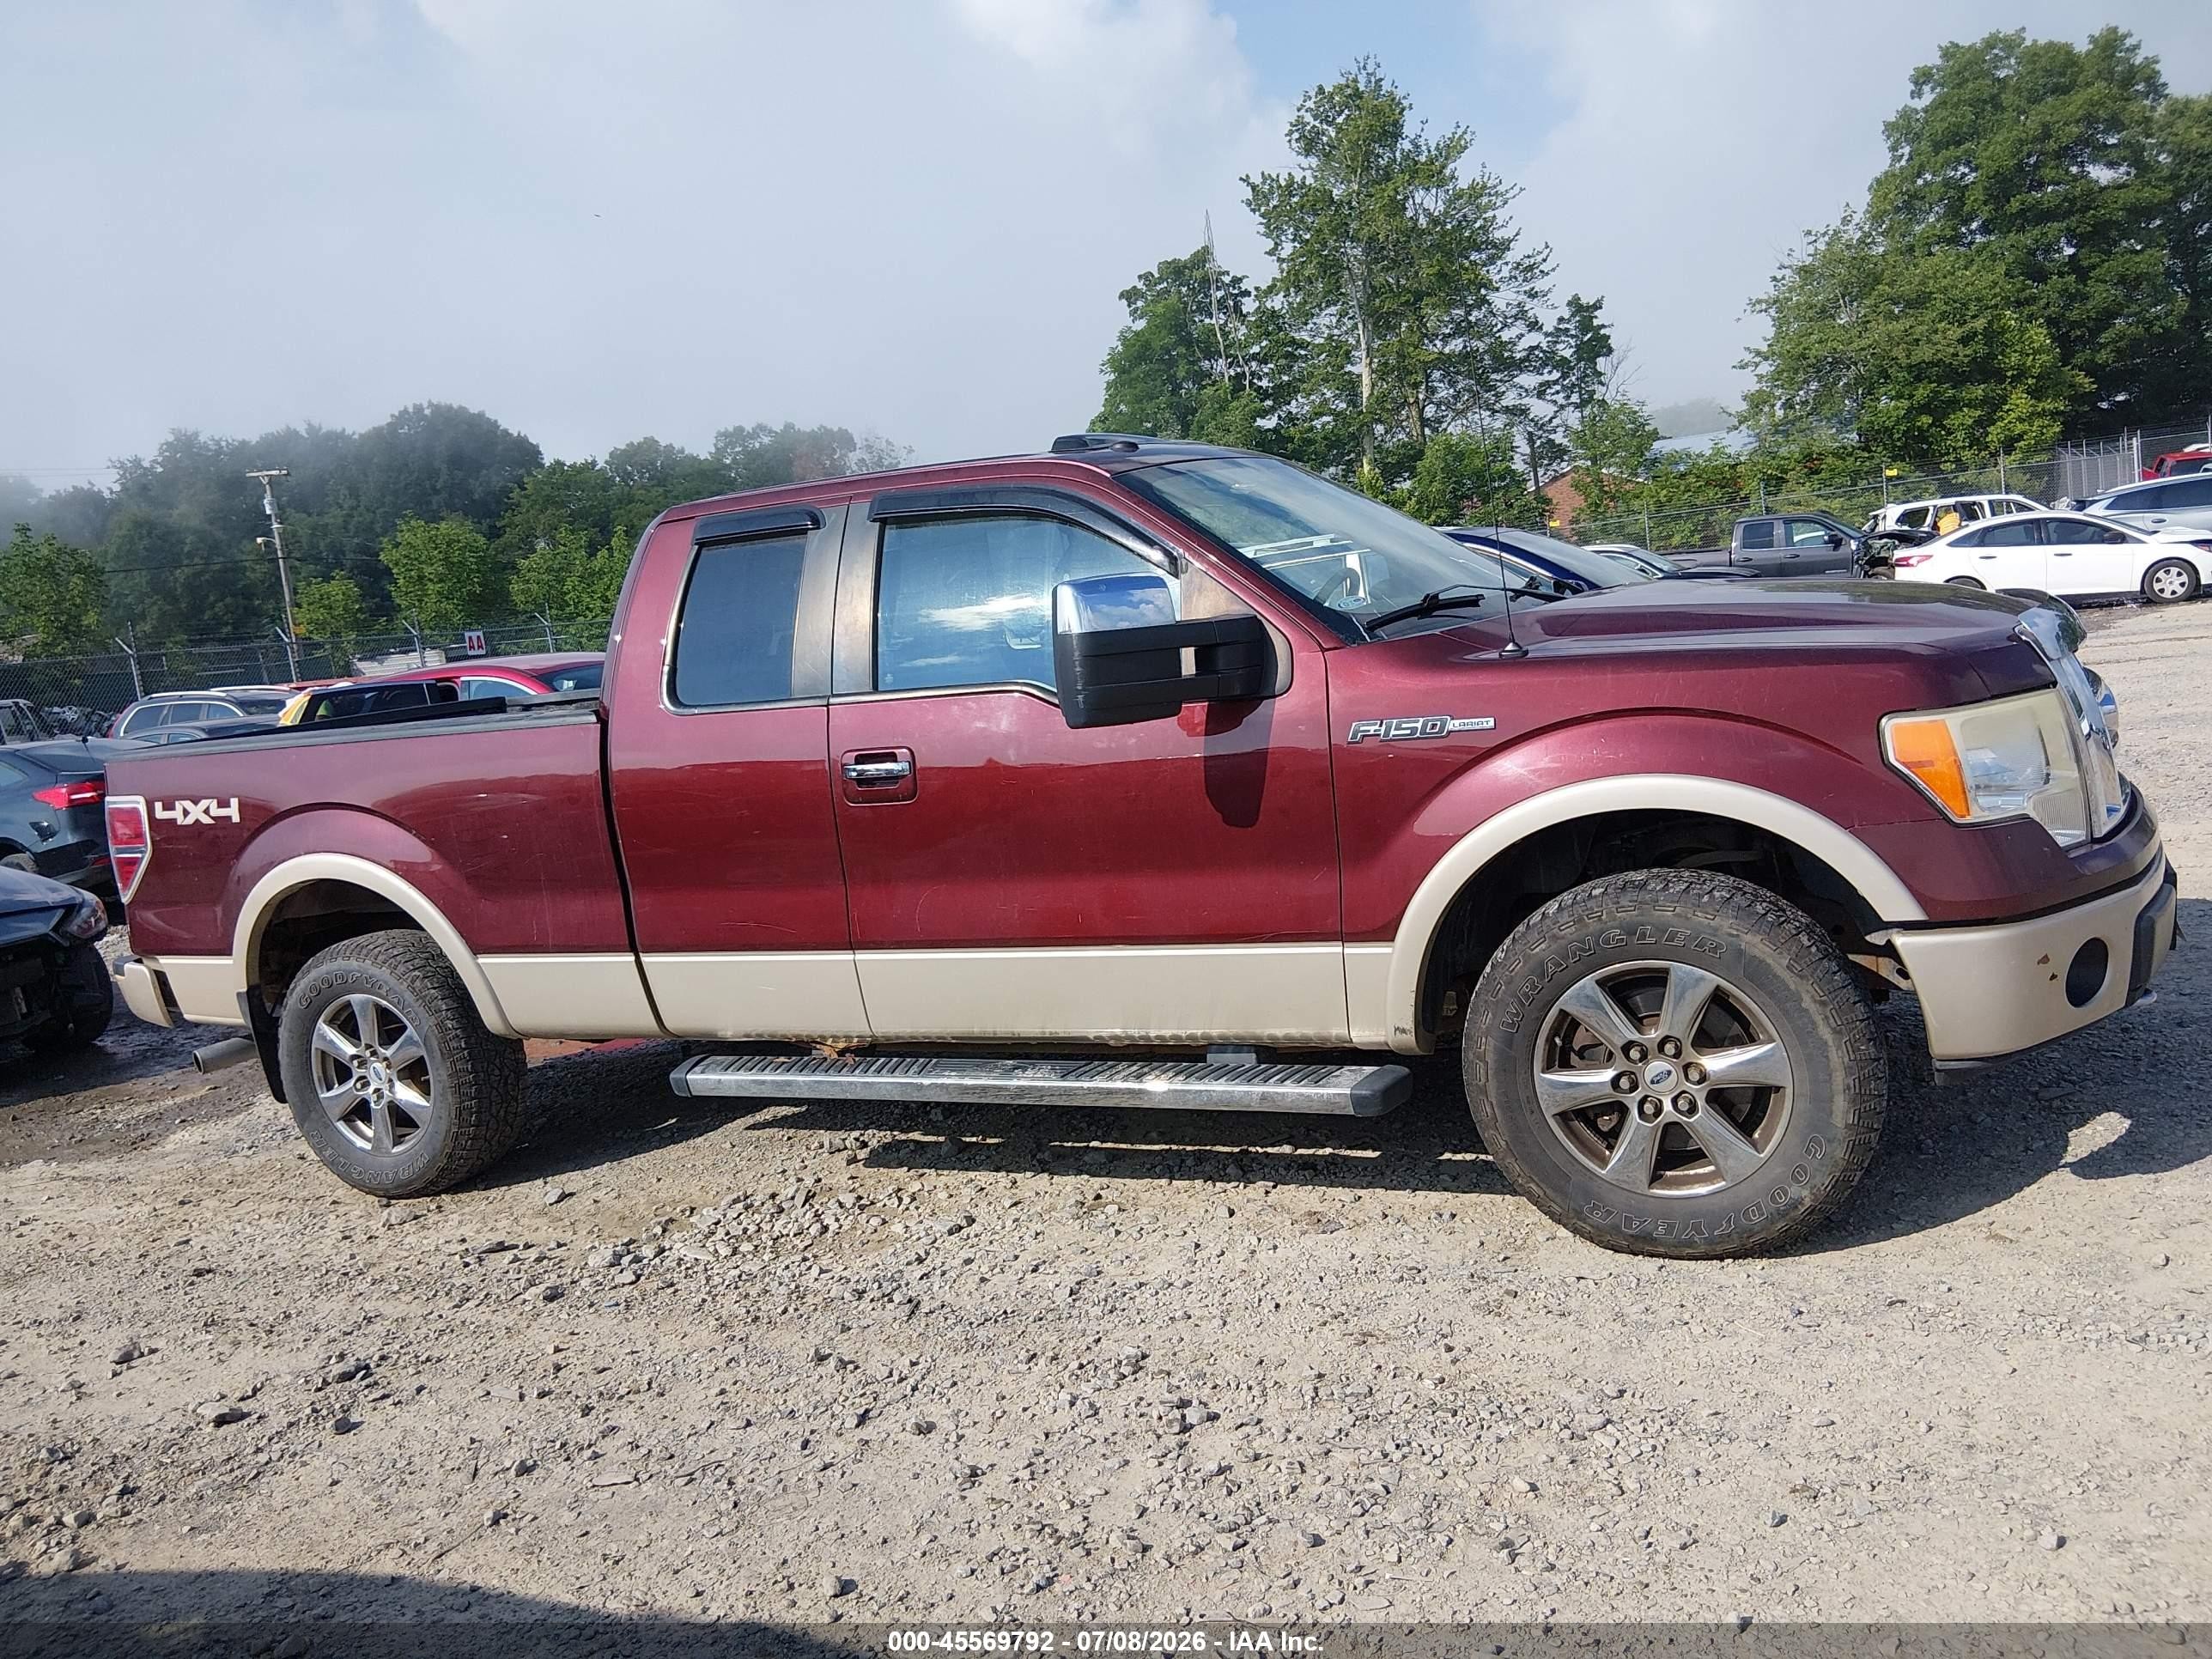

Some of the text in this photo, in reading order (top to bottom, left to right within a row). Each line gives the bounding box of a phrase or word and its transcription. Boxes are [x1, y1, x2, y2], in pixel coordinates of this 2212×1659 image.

[468, 635, 484, 651] AA
[1347, 715, 1492, 744] F-150 LARIAT
[299, 971, 421, 1027] GOODYEAR
[1500, 926, 1728, 1034] WRANGLER
[1651, 1070, 1669, 1085] Ford
[1583, 1133, 1826, 1239] GOODYEAR
